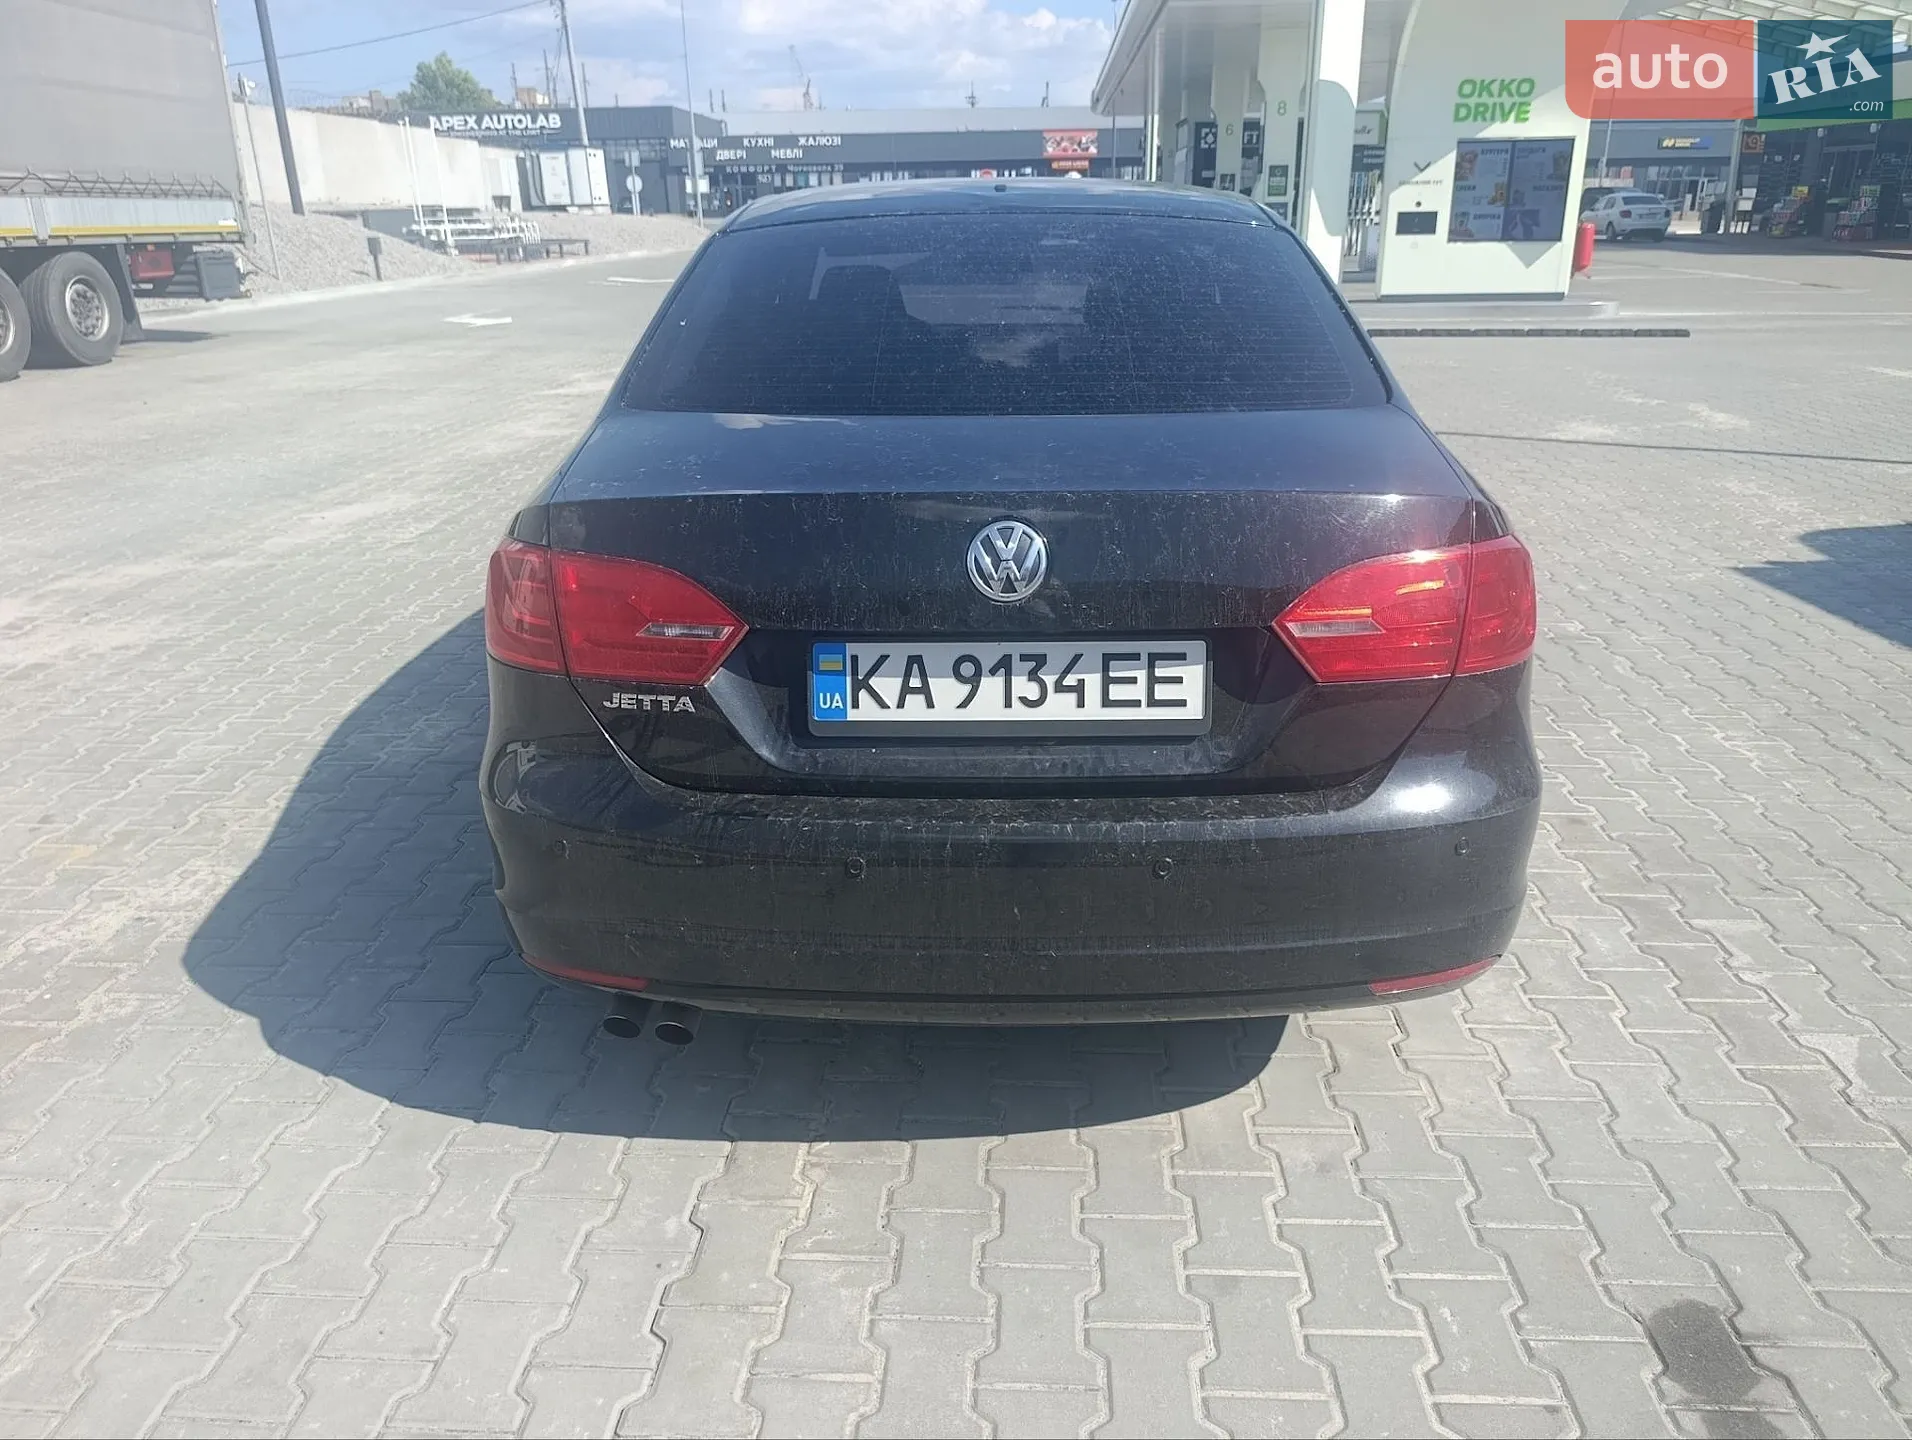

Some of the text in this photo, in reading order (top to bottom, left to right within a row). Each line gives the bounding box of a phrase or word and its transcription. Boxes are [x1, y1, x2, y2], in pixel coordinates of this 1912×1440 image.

[1457, 77, 1536, 99] OKKO
[1277, 100, 1288, 116] 8
[1453, 102, 1533, 124] DRIVE
[428, 113, 562, 131] APEX AUTOLAB
[1225, 124, 1234, 136] 6
[742, 136, 774, 148] КУХНІ
[797, 135, 842, 147] ЖАЛЮЗІ
[715, 149, 804, 161] ДВЕРІ МЕБЛІ
[602, 692, 696, 713] JETTA
[818, 692, 845, 710] UA
